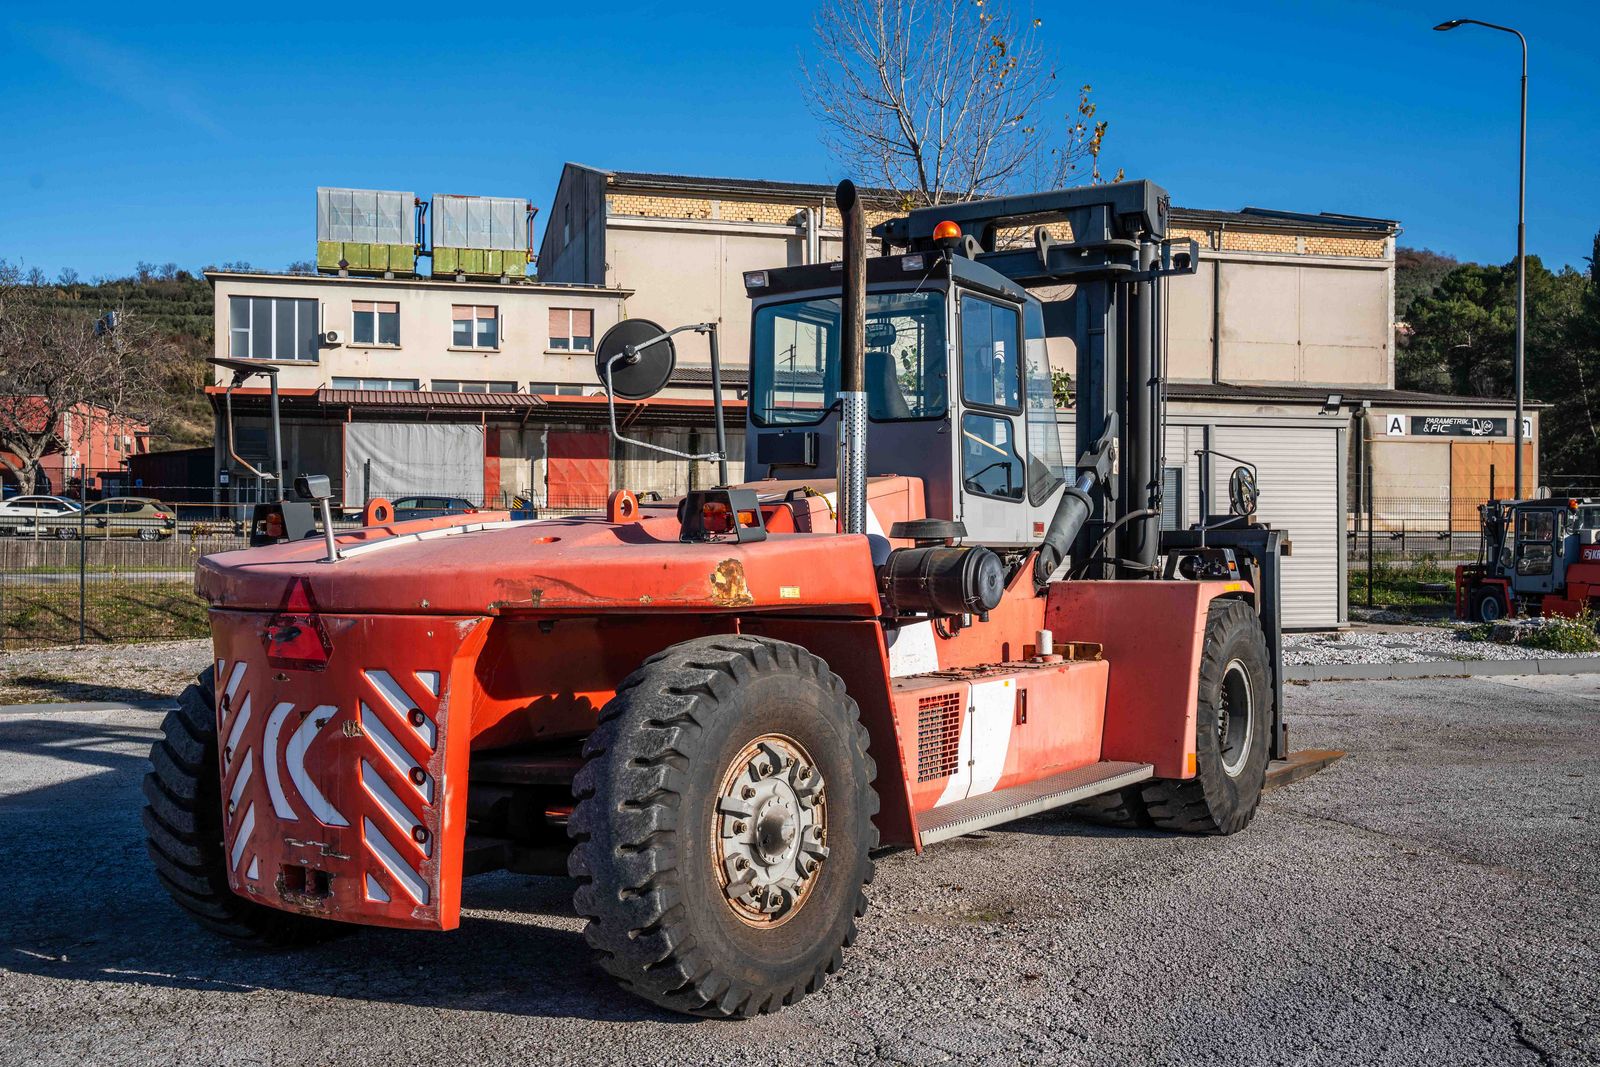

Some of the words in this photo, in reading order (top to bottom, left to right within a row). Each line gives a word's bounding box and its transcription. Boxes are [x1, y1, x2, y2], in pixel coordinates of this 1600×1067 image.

[1390, 417, 1402, 432] A
[1423, 424, 1430, 433] &
[1430, 424, 1450, 433] FIC
